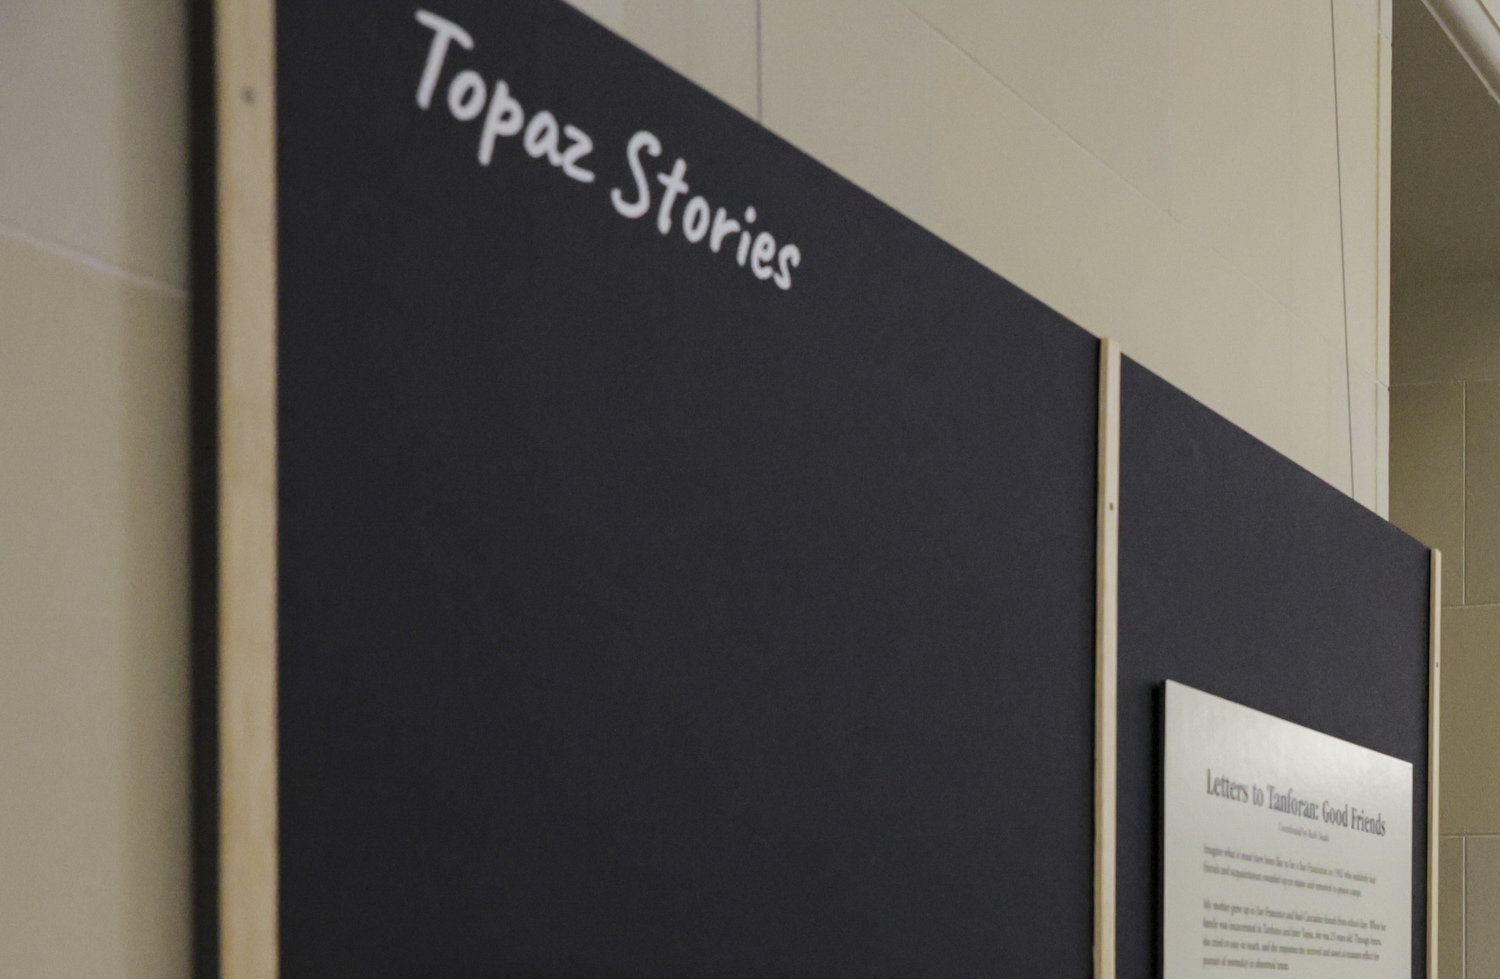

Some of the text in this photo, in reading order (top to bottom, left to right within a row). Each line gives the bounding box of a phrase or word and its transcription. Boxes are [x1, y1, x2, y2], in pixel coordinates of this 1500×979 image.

[415, 9, 800, 290] Topaz Stories
[1206, 768, 1249, 804] Letters
[1252, 783, 1264, 807] to
[1267, 784, 1319, 820] Tanforan:
[1322, 799, 1348, 828] Good
[1351, 806, 1386, 836] Friends
